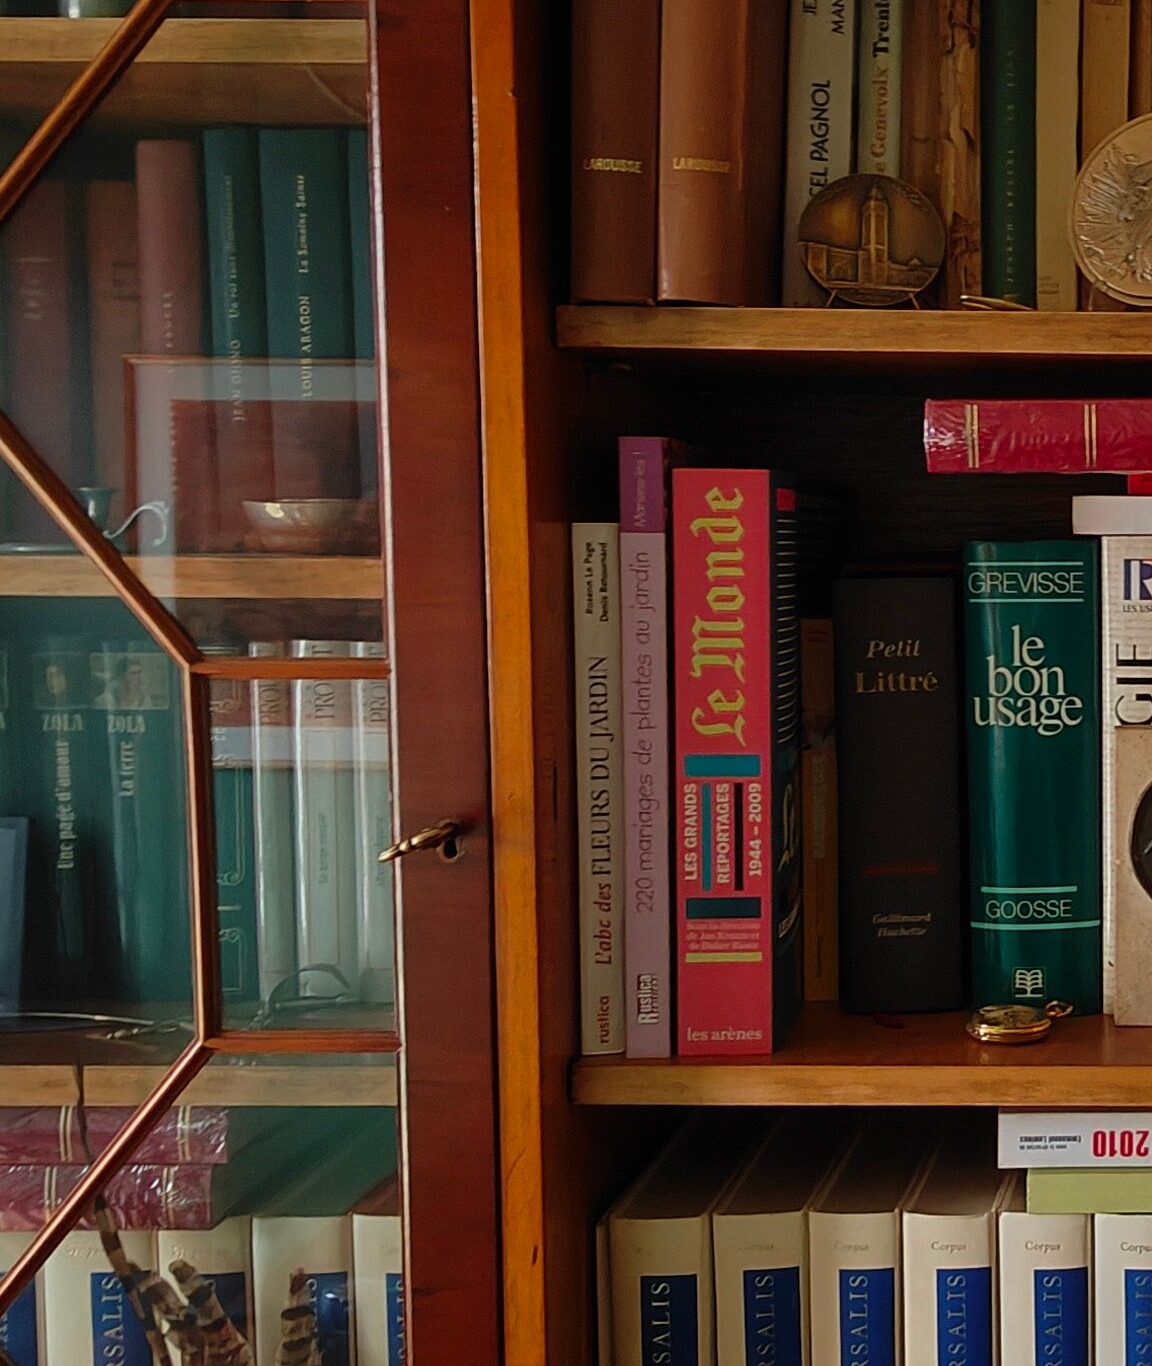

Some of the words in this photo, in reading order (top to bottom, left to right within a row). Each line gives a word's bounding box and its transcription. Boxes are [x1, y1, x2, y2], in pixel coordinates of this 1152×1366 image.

[809, 79, 832, 162] PAGNOL
[870, 65, 889, 158] Genevoix
[298, 295, 313, 354] ARAGON
[301, 357, 314, 399] LOUIS
[629, 551, 656, 611] jardin
[689, 485, 747, 685] Monde
[967, 571, 1085, 594] GREVISSE
[1122, 604, 1138, 613] LES
[635, 619, 651, 645] au
[866, 639, 921, 659] Petit
[1011, 624, 1046, 667] le
[629, 653, 654, 731] plantes
[855, 670, 940, 693] Littré
[985, 654, 1067, 697] bon
[588, 656, 615, 743] JARDIN
[691, 688, 747, 748] Le
[973, 696, 1084, 736] usage
[41, 713, 84, 732] ZOLA
[107, 714, 146, 733] ZOLA
[54, 739, 72, 802] d'amour
[590, 746, 611, 782] DU
[632, 738, 652, 766] de
[683, 782, 698, 848] GRANDS
[748, 781, 763, 822] 2009
[55, 804, 78, 840] page
[590, 788, 612, 876] FLEURS
[632, 773, 660, 872] mariages
[716, 782, 731, 885] REPORTAGES
[57, 841, 75, 869] Une
[684, 853, 698, 882] LES
[748, 837, 763, 877] 1944
[593, 882, 612, 913] des
[635, 877, 654, 913] 220
[985, 899, 1072, 919] GOOSSE
[592, 919, 612, 966] L'abc
[597, 995, 610, 1044] rustica
[687, 1026, 708, 1042] les
[710, 1023, 763, 1042] arènes
[1092, 1129, 1151, 1158] 2010
[931, 1241, 967, 1253] Corpus
[1025, 1240, 1061, 1252] Corpus
